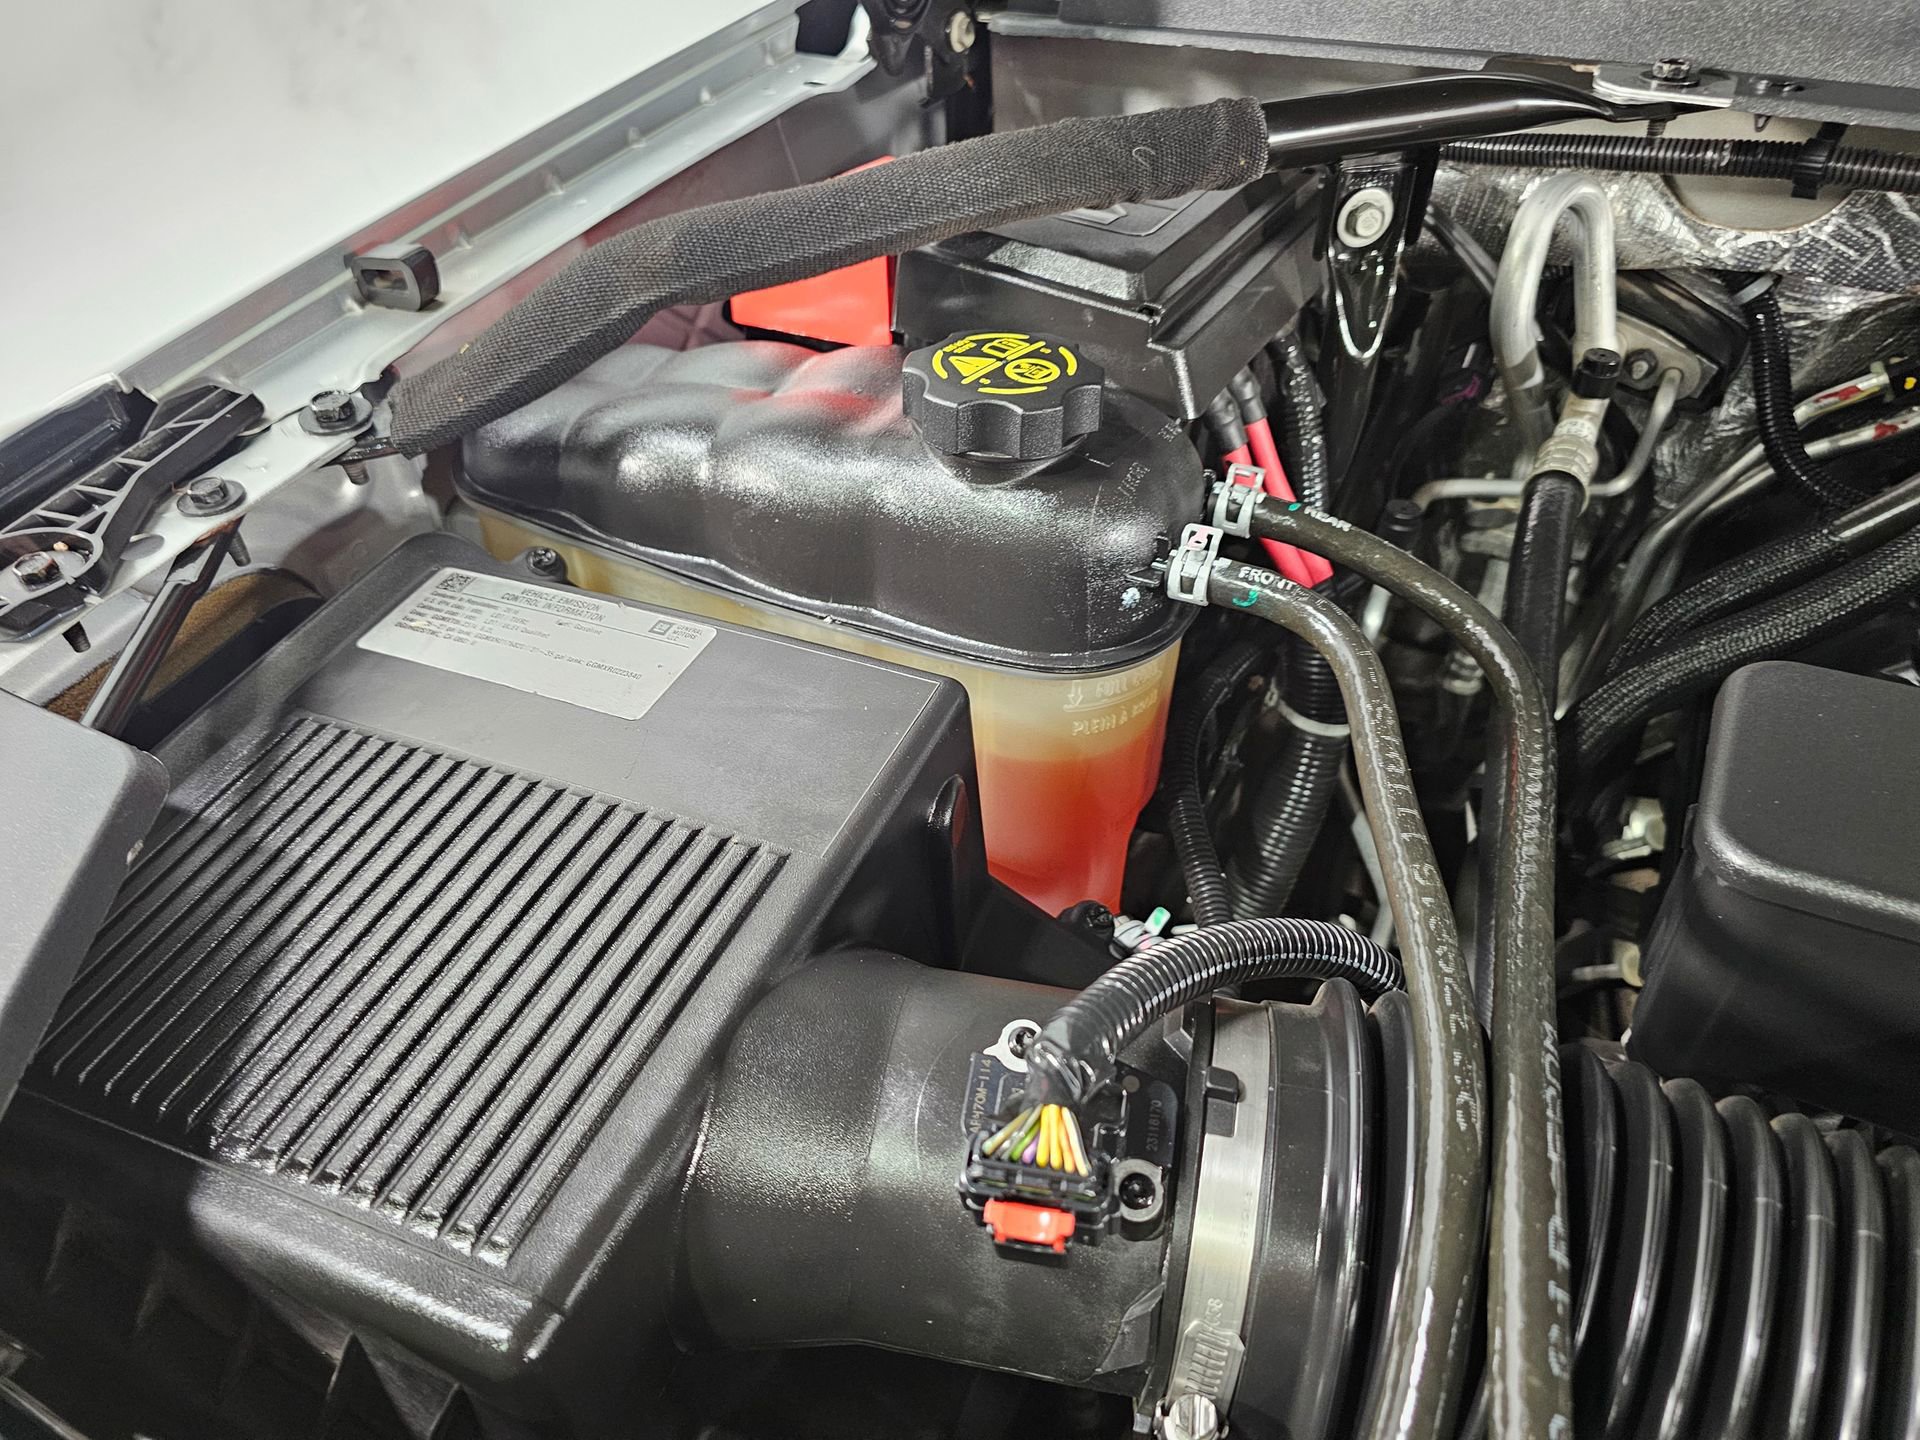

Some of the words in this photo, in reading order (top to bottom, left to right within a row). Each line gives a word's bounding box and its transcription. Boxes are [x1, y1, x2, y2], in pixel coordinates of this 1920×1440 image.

[1303, 506, 1352, 532] REAR
[501, 592, 539, 608] CONTROL
[542, 602, 606, 622] INFORMATION
[521, 588, 557, 601] VEHICLE
[559, 597, 602, 612] EMISSION
